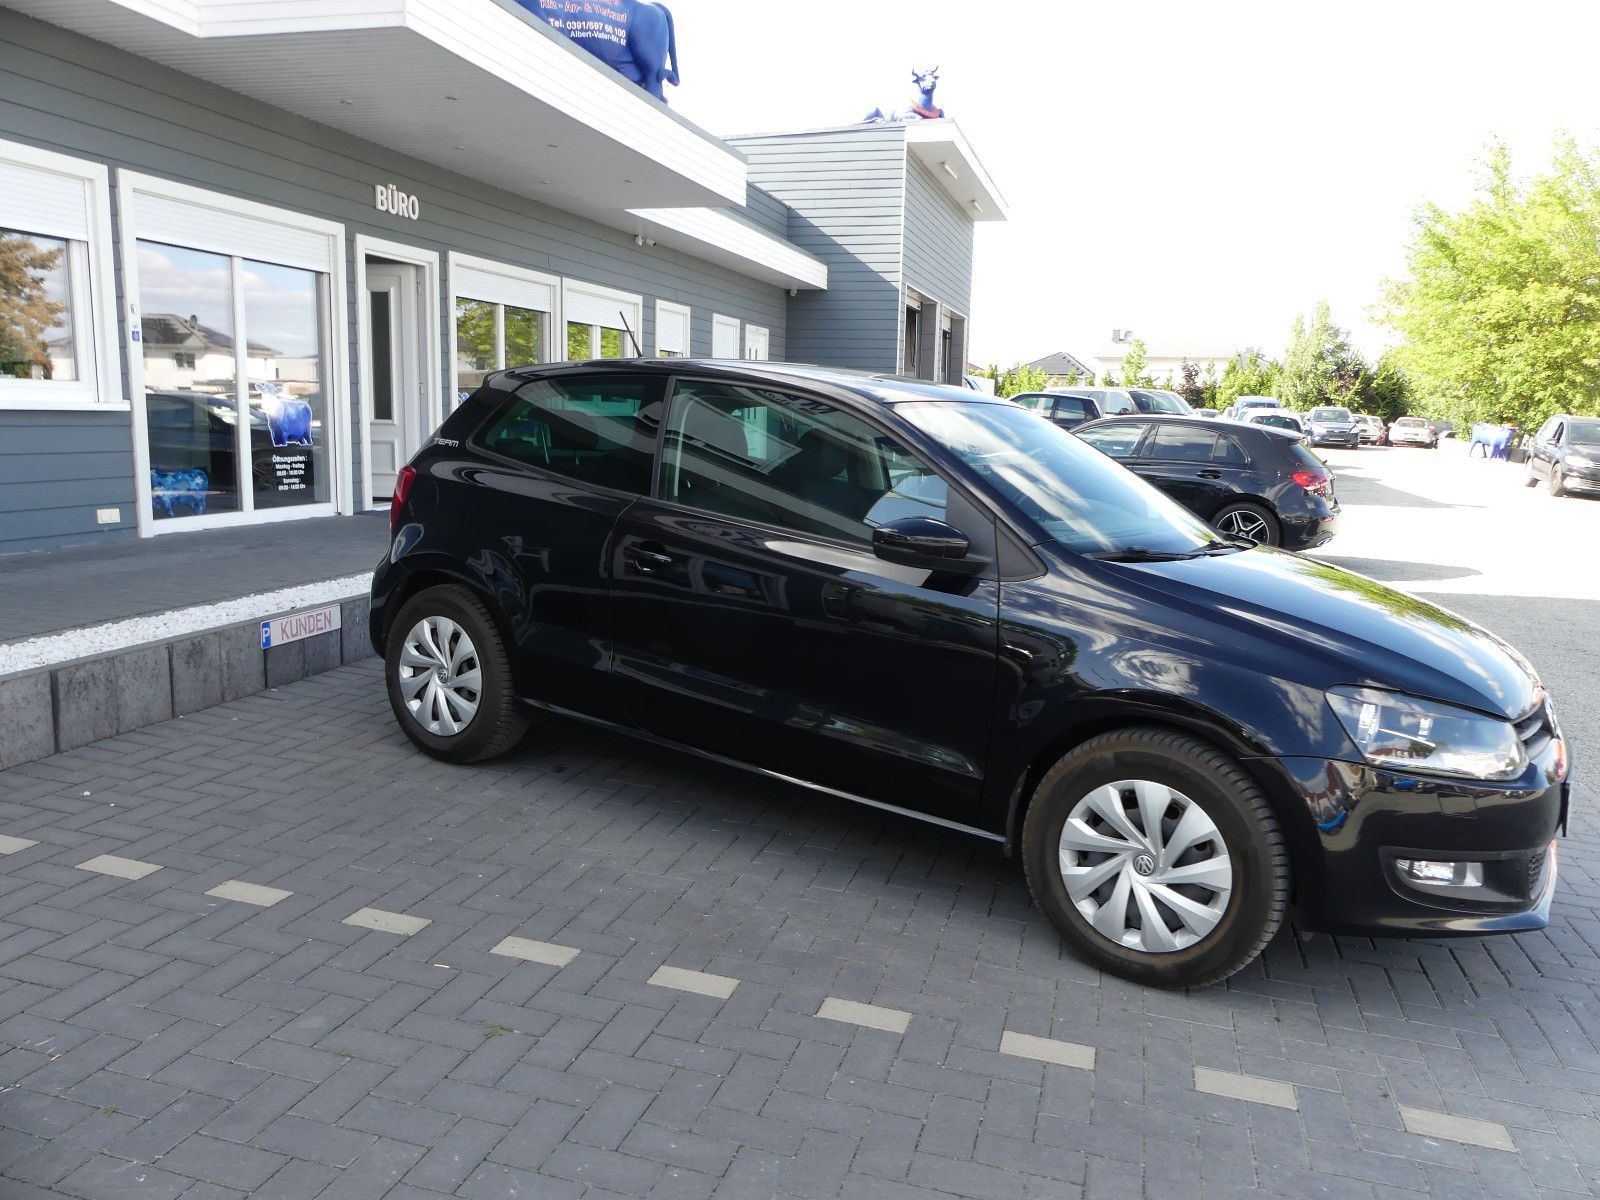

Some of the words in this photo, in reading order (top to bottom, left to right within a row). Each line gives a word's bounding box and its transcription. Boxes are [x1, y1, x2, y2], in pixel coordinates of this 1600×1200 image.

[549, 18, 564, 28] Tel.
[566, 21, 603, 30] 0391/597
[614, 27, 626, 38] 100
[375, 183, 419, 220] BÜRO
[263, 628, 270, 643] P
[280, 610, 332, 641] KUNDEN
